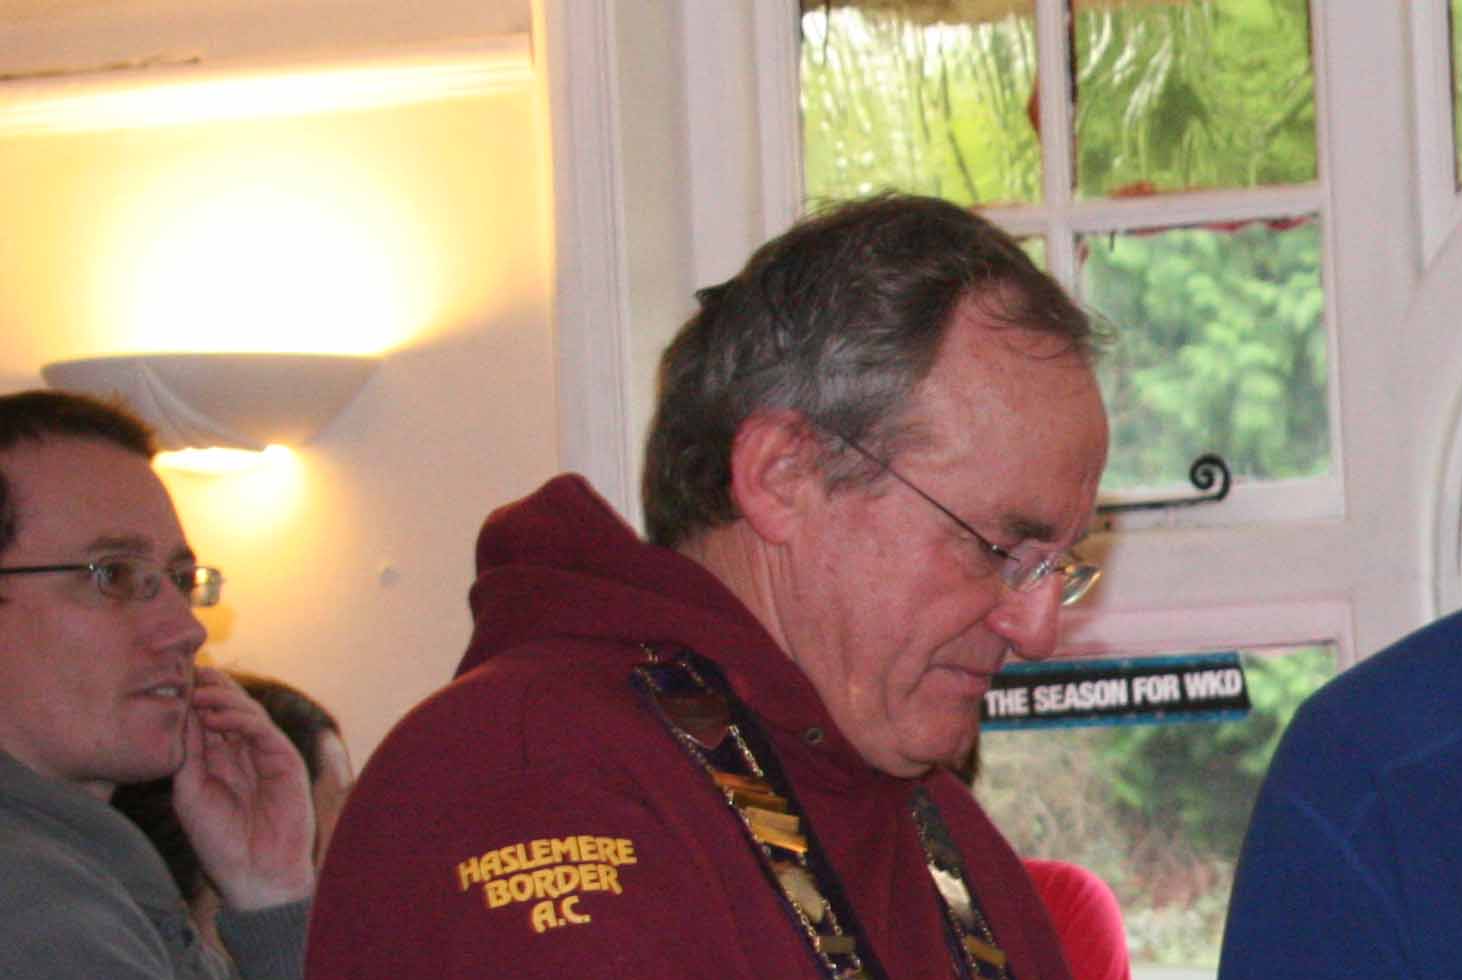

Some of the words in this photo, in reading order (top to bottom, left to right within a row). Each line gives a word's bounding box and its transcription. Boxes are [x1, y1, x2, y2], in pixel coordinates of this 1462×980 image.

[984, 688, 1029, 717] THE
[1033, 678, 1127, 713] SEASON
[1132, 672, 1179, 705] FOR
[1183, 669, 1243, 699] WKD
[458, 835, 638, 891] HASLEMERE
[485, 863, 623, 909] BORDER
